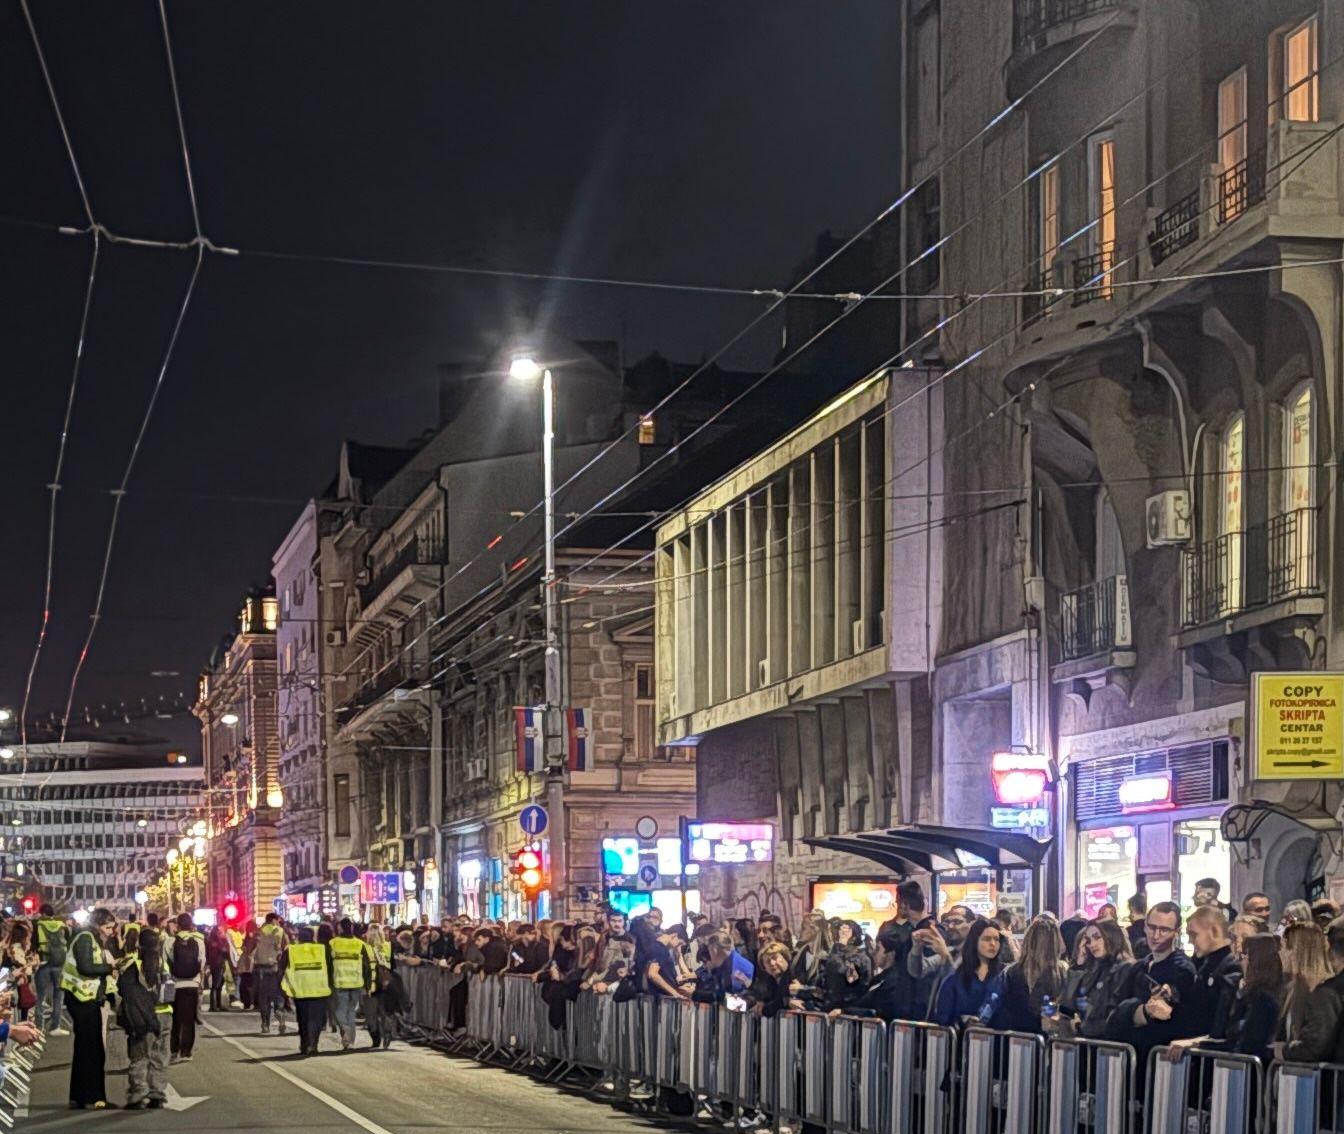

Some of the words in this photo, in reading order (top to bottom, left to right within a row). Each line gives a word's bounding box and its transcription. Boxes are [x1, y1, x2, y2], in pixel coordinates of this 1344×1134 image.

[1283, 686, 1324, 697] COPY
[1279, 710, 1326, 721] SKRIPTA
[1280, 724, 1324, 732] CENTAR
